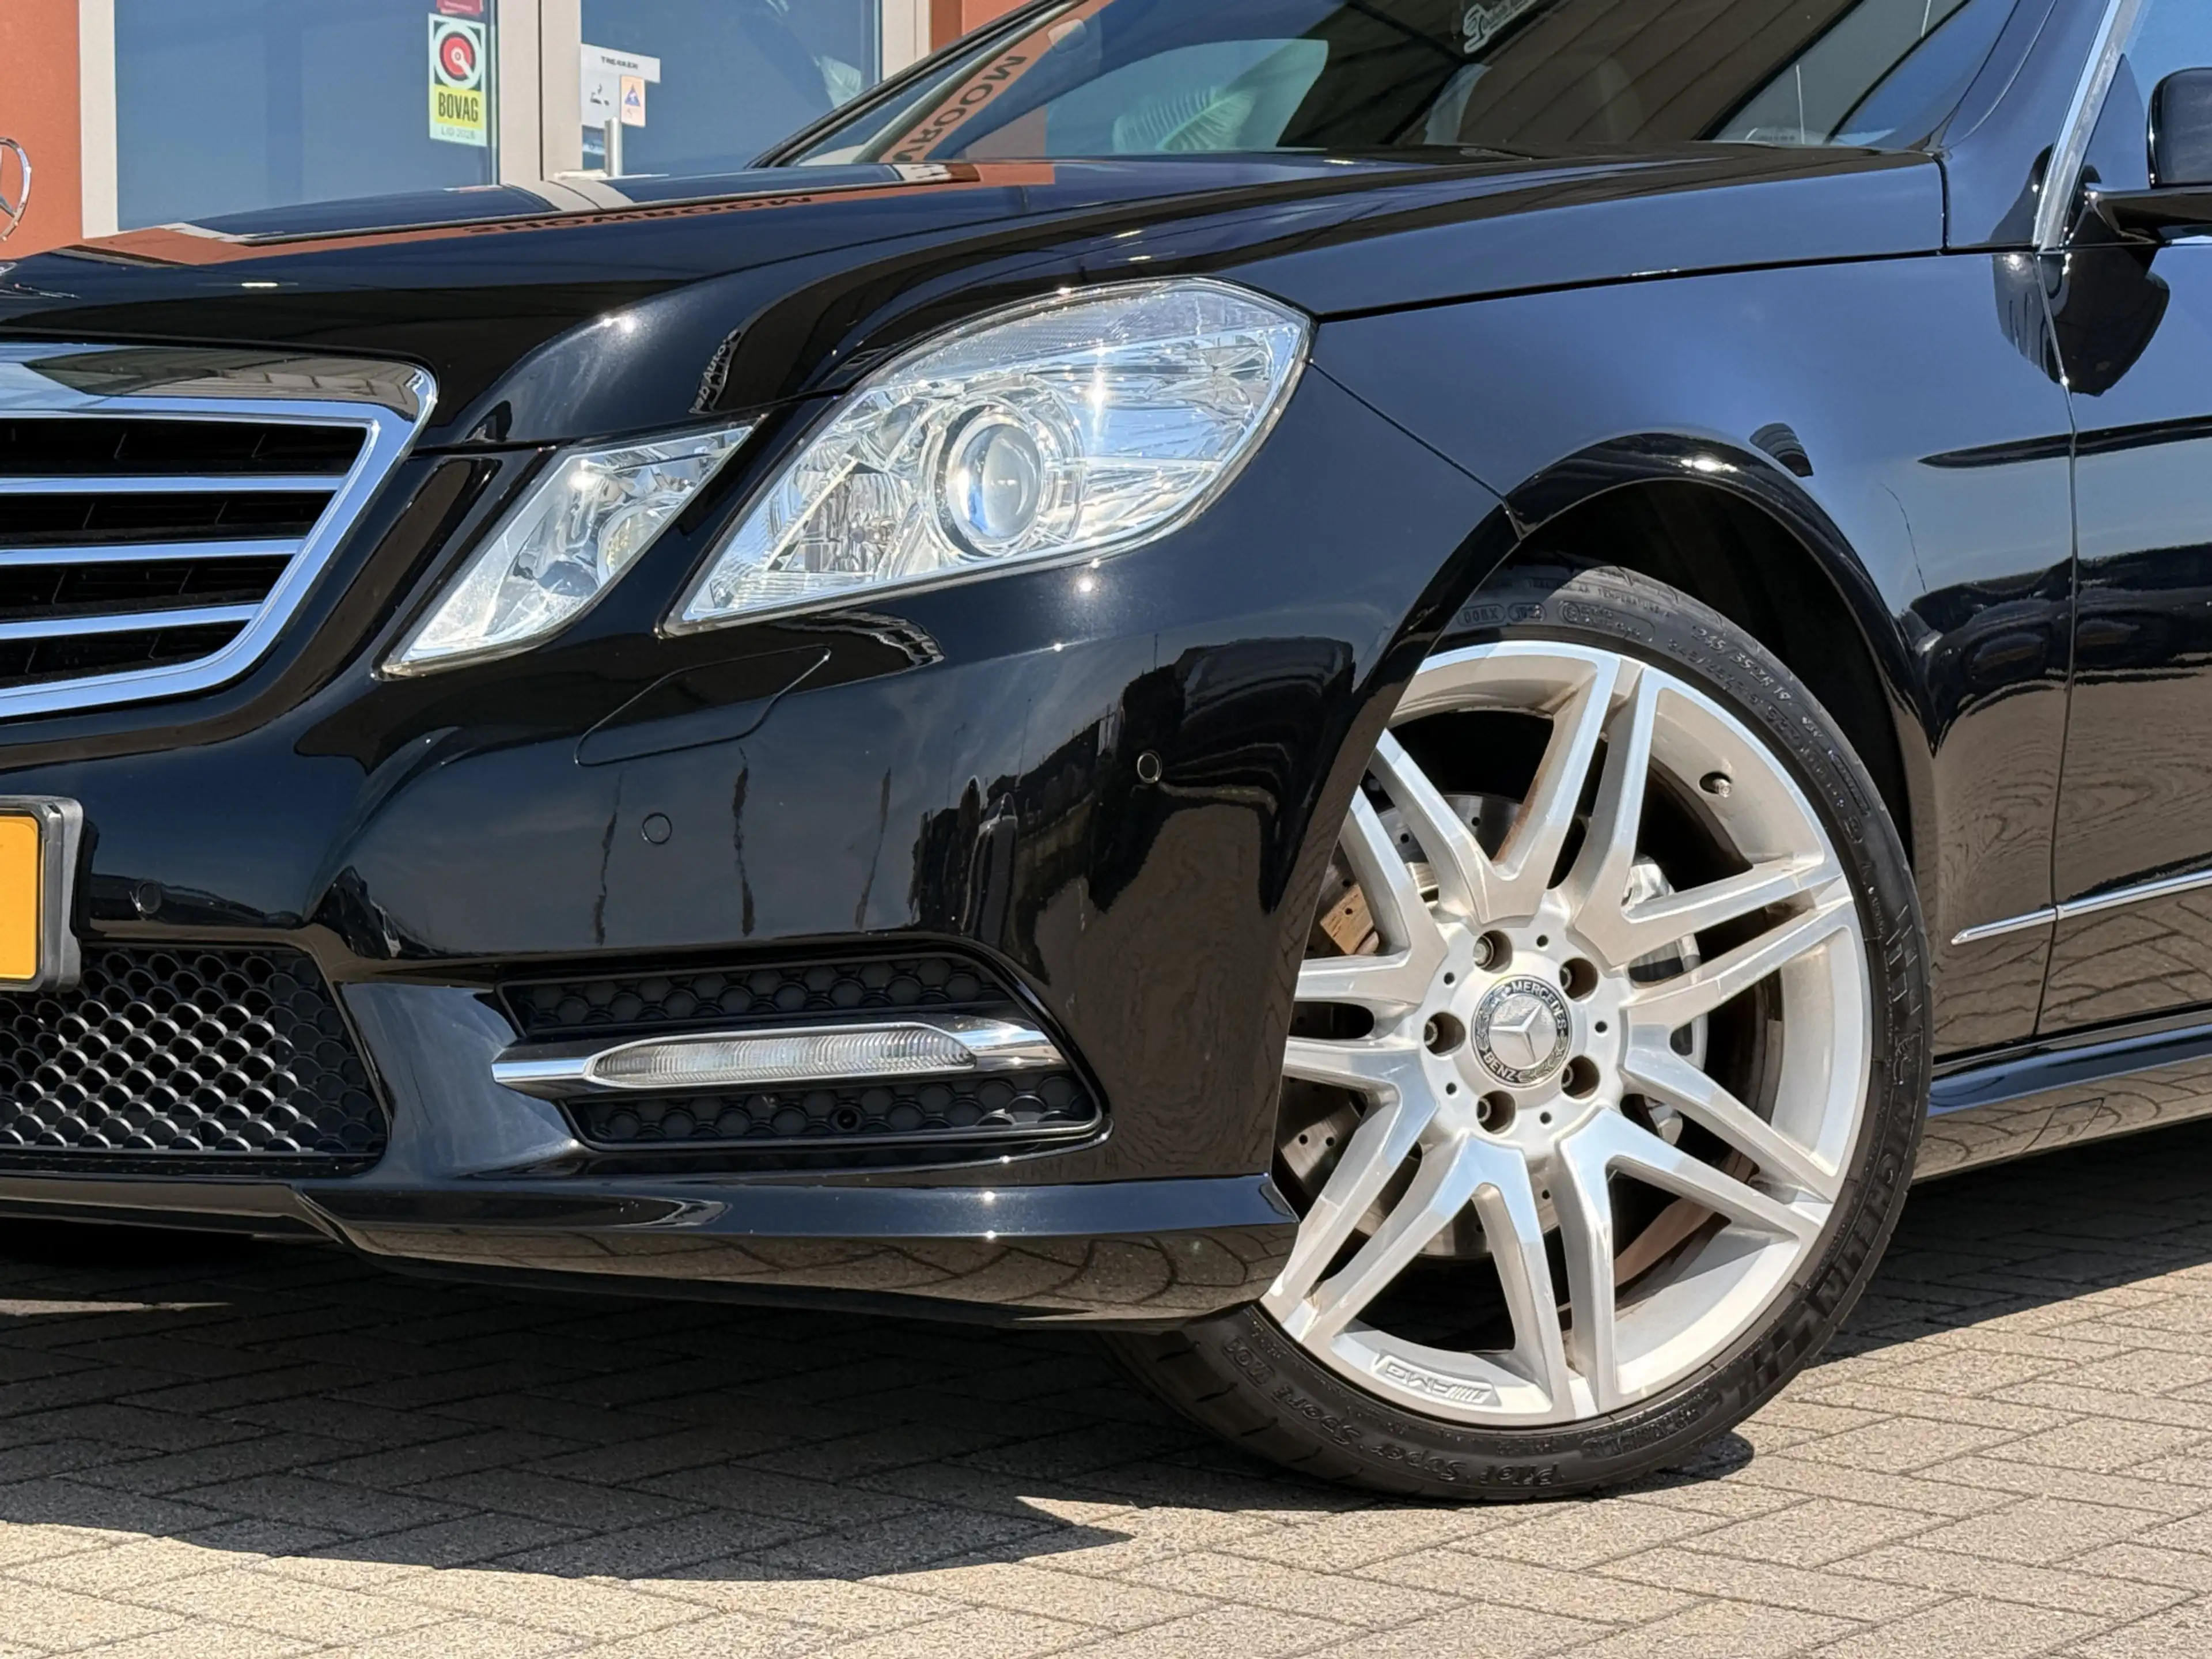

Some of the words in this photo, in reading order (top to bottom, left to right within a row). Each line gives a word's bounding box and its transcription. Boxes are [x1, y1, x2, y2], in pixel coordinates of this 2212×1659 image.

[438, 92, 479, 122] BOVAG
[1513, 981, 1567, 1029] MERCEDES
[1484, 1053, 1517, 1081] BENZ
